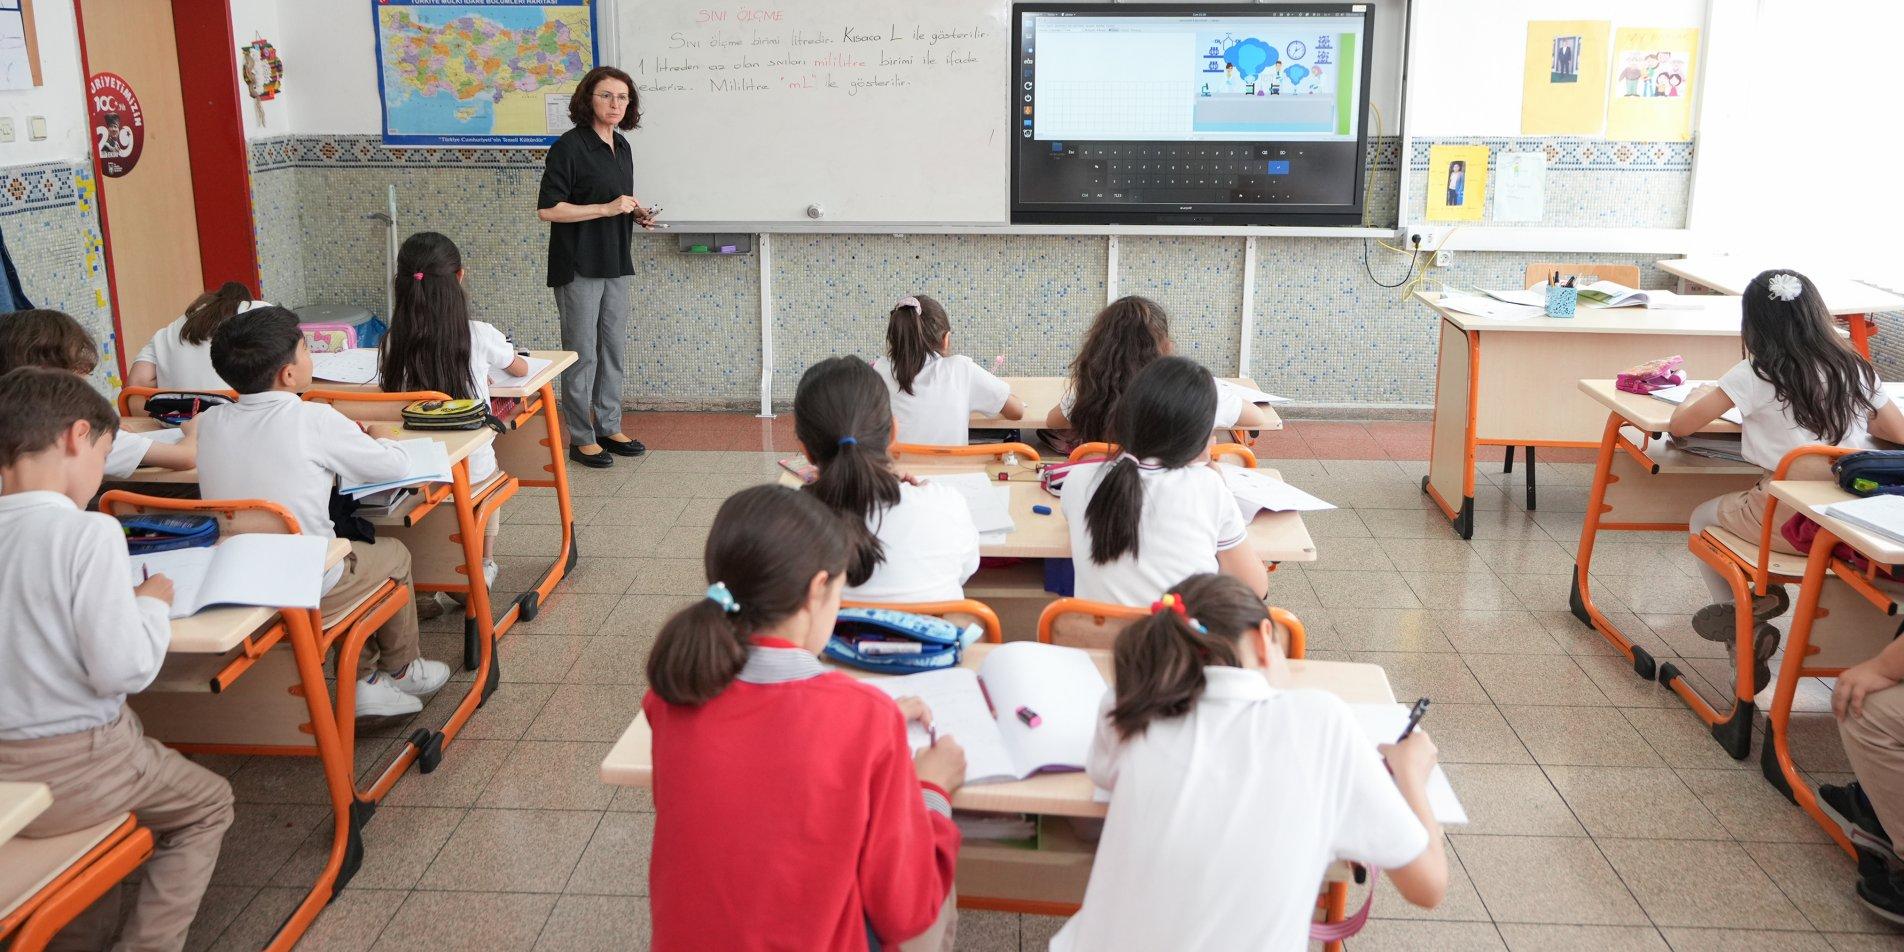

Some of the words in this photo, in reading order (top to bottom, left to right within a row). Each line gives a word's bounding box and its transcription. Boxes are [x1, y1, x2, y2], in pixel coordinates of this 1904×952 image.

[736, 6, 784, 23] ÖLÇME
[709, 30, 743, 49] ölçme
[751, 28, 780, 46] birimi
[890, 23, 903, 41] L
[913, 25, 925, 41] ile
[638, 58, 645, 75] 1
[656, 56, 699, 73] litreden
[733, 55, 760, 70] olan
[814, 51, 866, 67] mililitre
[879, 49, 914, 66] birimi
[923, 49, 937, 65] ile
[946, 49, 979, 66] ifade
[709, 77, 770, 92] Mililitre
[824, 73, 839, 88] ile
[96, 125, 134, 159] 29
